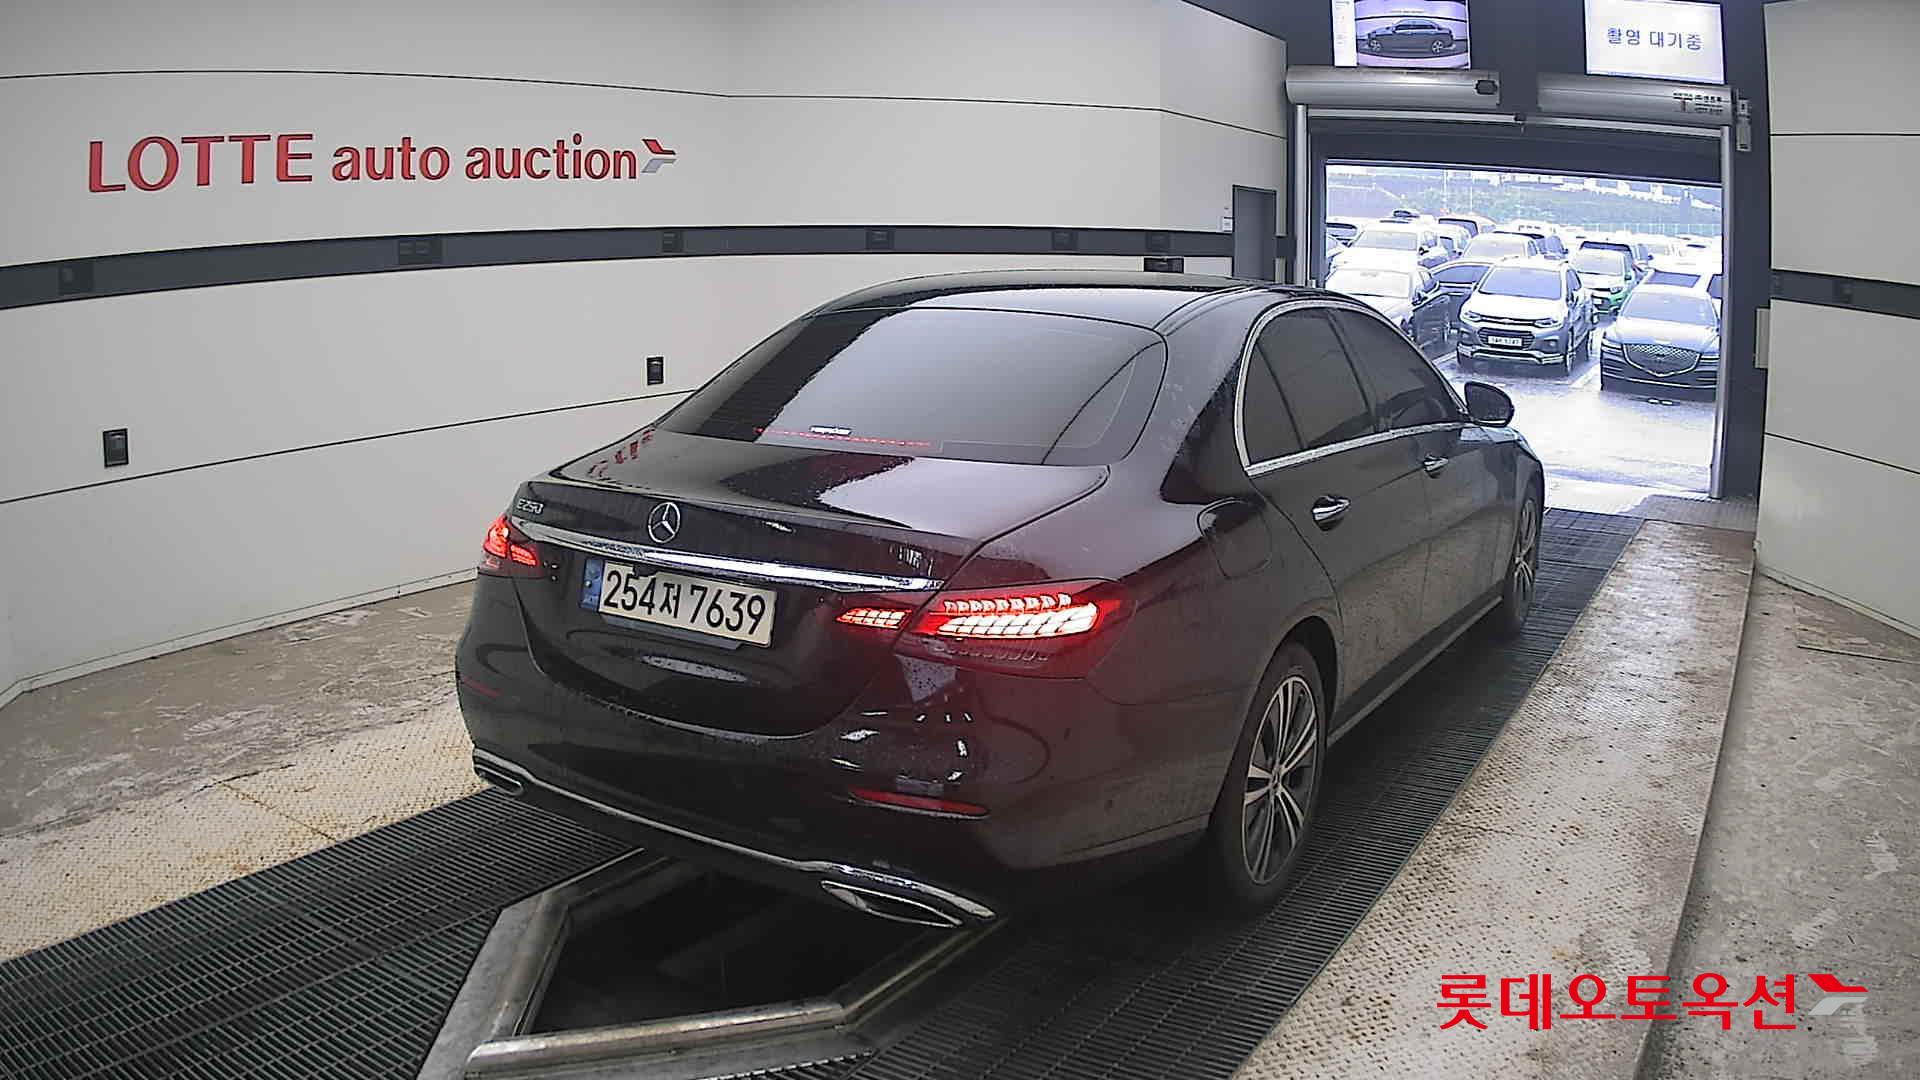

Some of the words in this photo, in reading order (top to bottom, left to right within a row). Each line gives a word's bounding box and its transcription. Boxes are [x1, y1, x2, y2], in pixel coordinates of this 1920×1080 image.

[1649, 31, 1702, 51] 대기중
[88, 133, 314, 193] LOTTE
[331, 136, 450, 181] auto
[464, 133, 638, 180] auction
[603, 569, 682, 619] 254저
[690, 583, 766, 636] 7639
